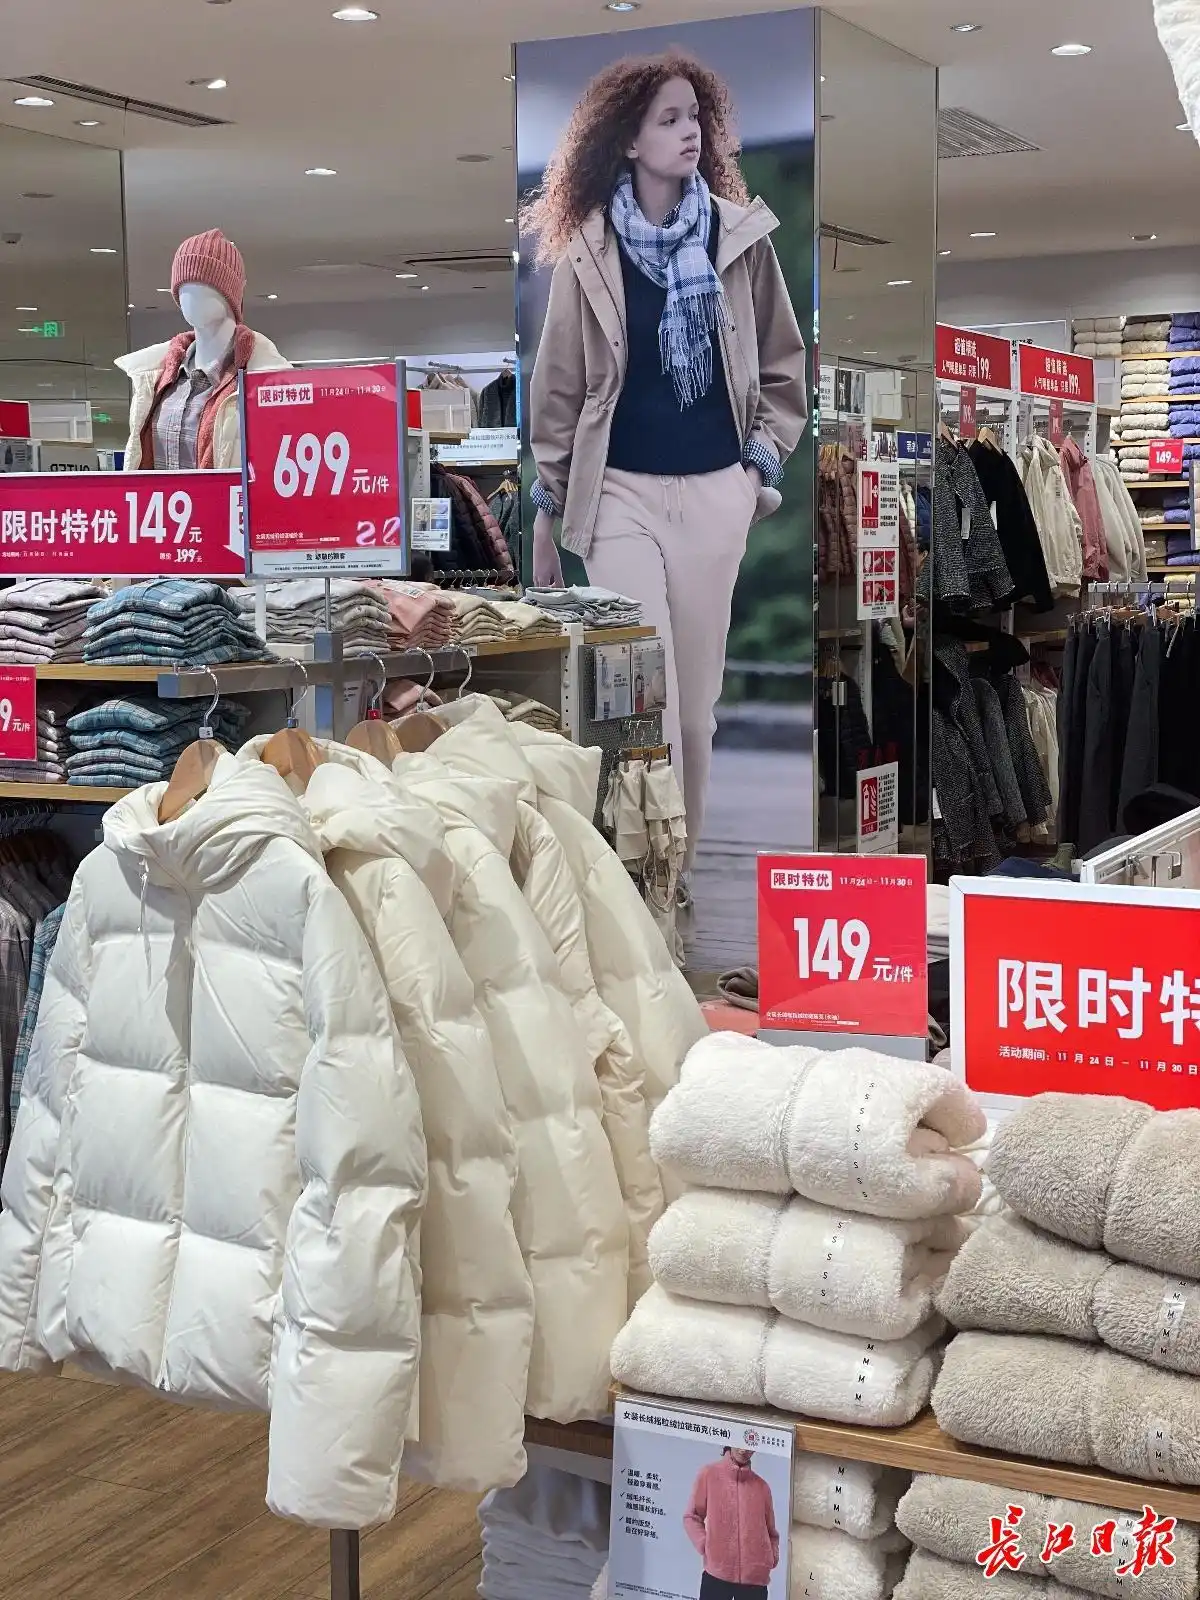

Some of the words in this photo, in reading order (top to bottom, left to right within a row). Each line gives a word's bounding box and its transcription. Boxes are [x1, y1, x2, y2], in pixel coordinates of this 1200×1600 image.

[259, 387, 311, 403] 限时特优
[1, 509, 119, 544] 限时特优
[773, 872, 830, 887] 限时特优
